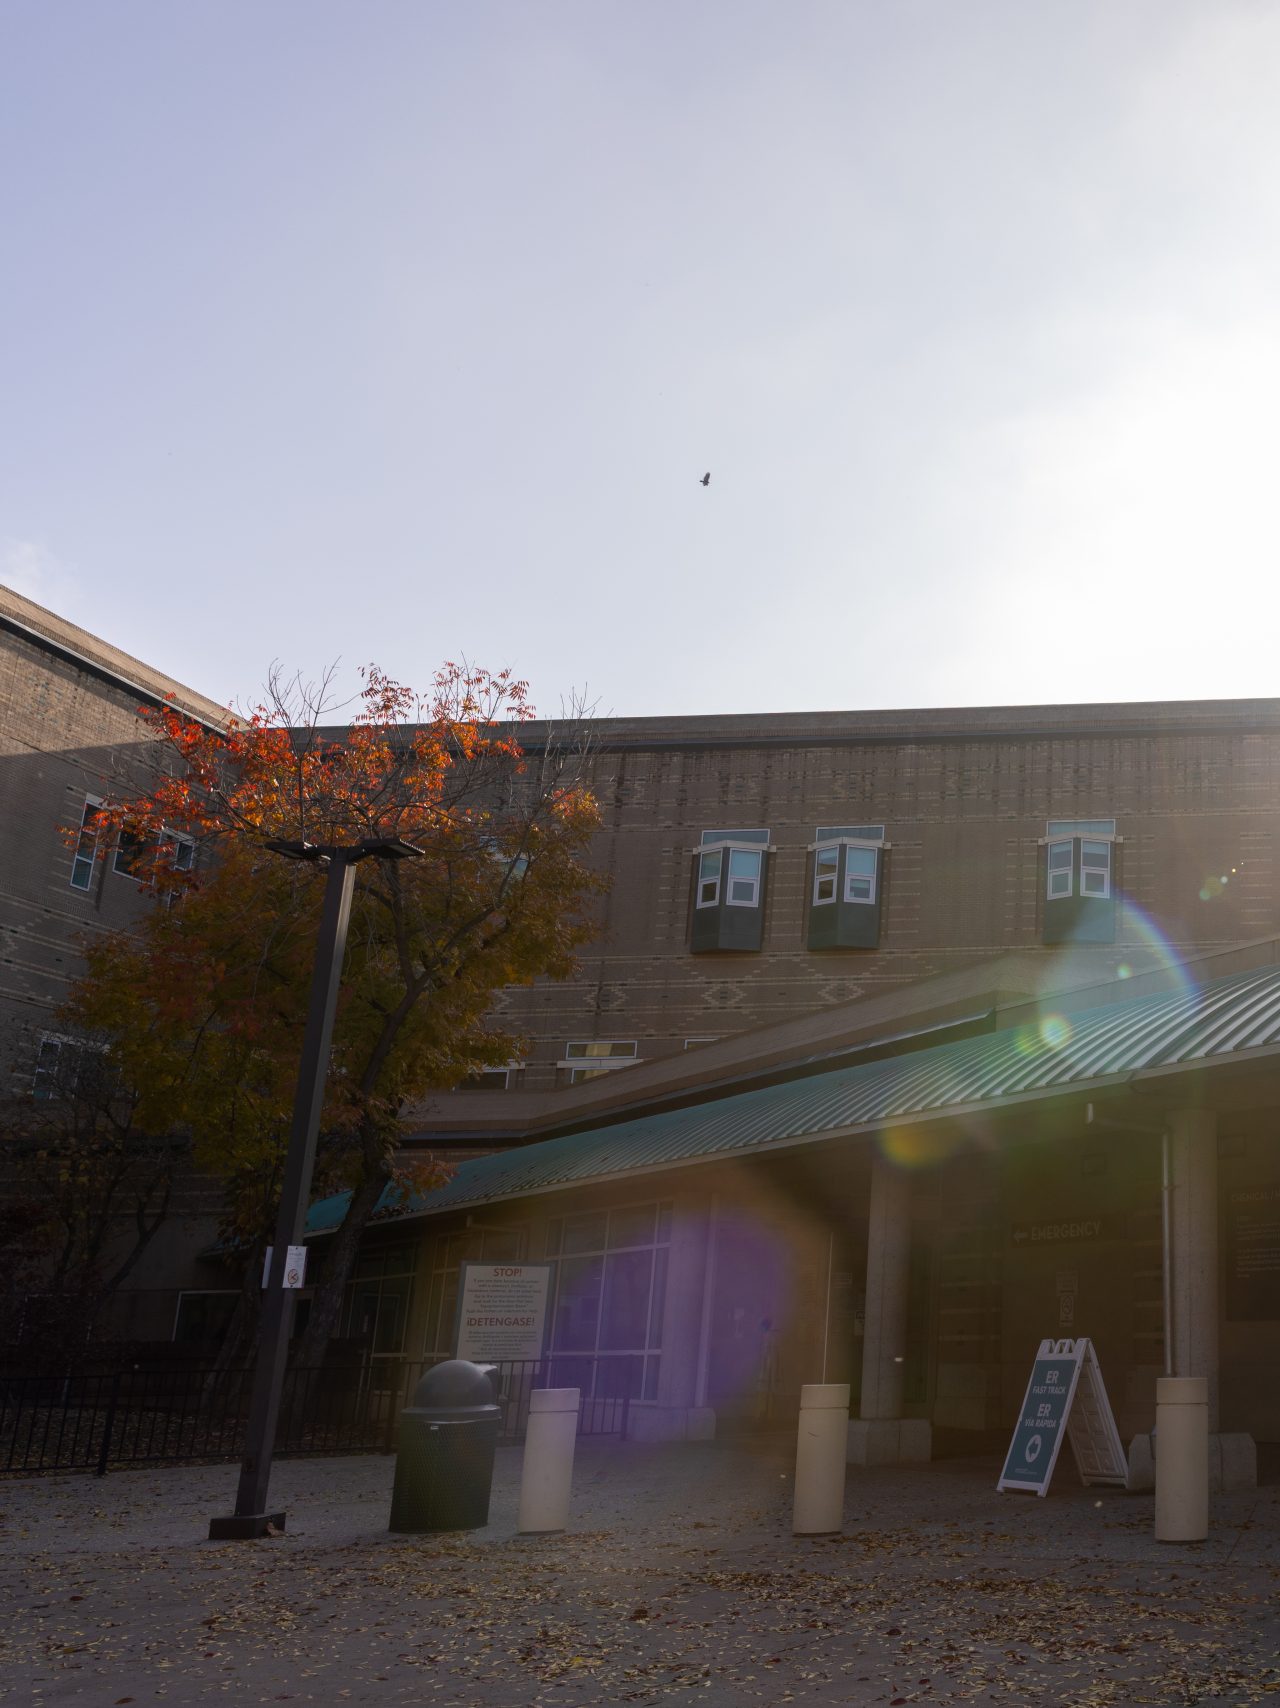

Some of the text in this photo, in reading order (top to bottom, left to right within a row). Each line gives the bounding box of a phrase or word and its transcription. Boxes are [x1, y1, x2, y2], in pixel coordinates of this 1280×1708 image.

[1031, 1220, 1101, 1241] EMERGENCY
[493, 1268, 522, 1277] STOP!
[1045, 1370, 1060, 1384] ER
[1032, 1386, 1066, 1395] FAST TRACK
[1037, 1403, 1052, 1417] ER
